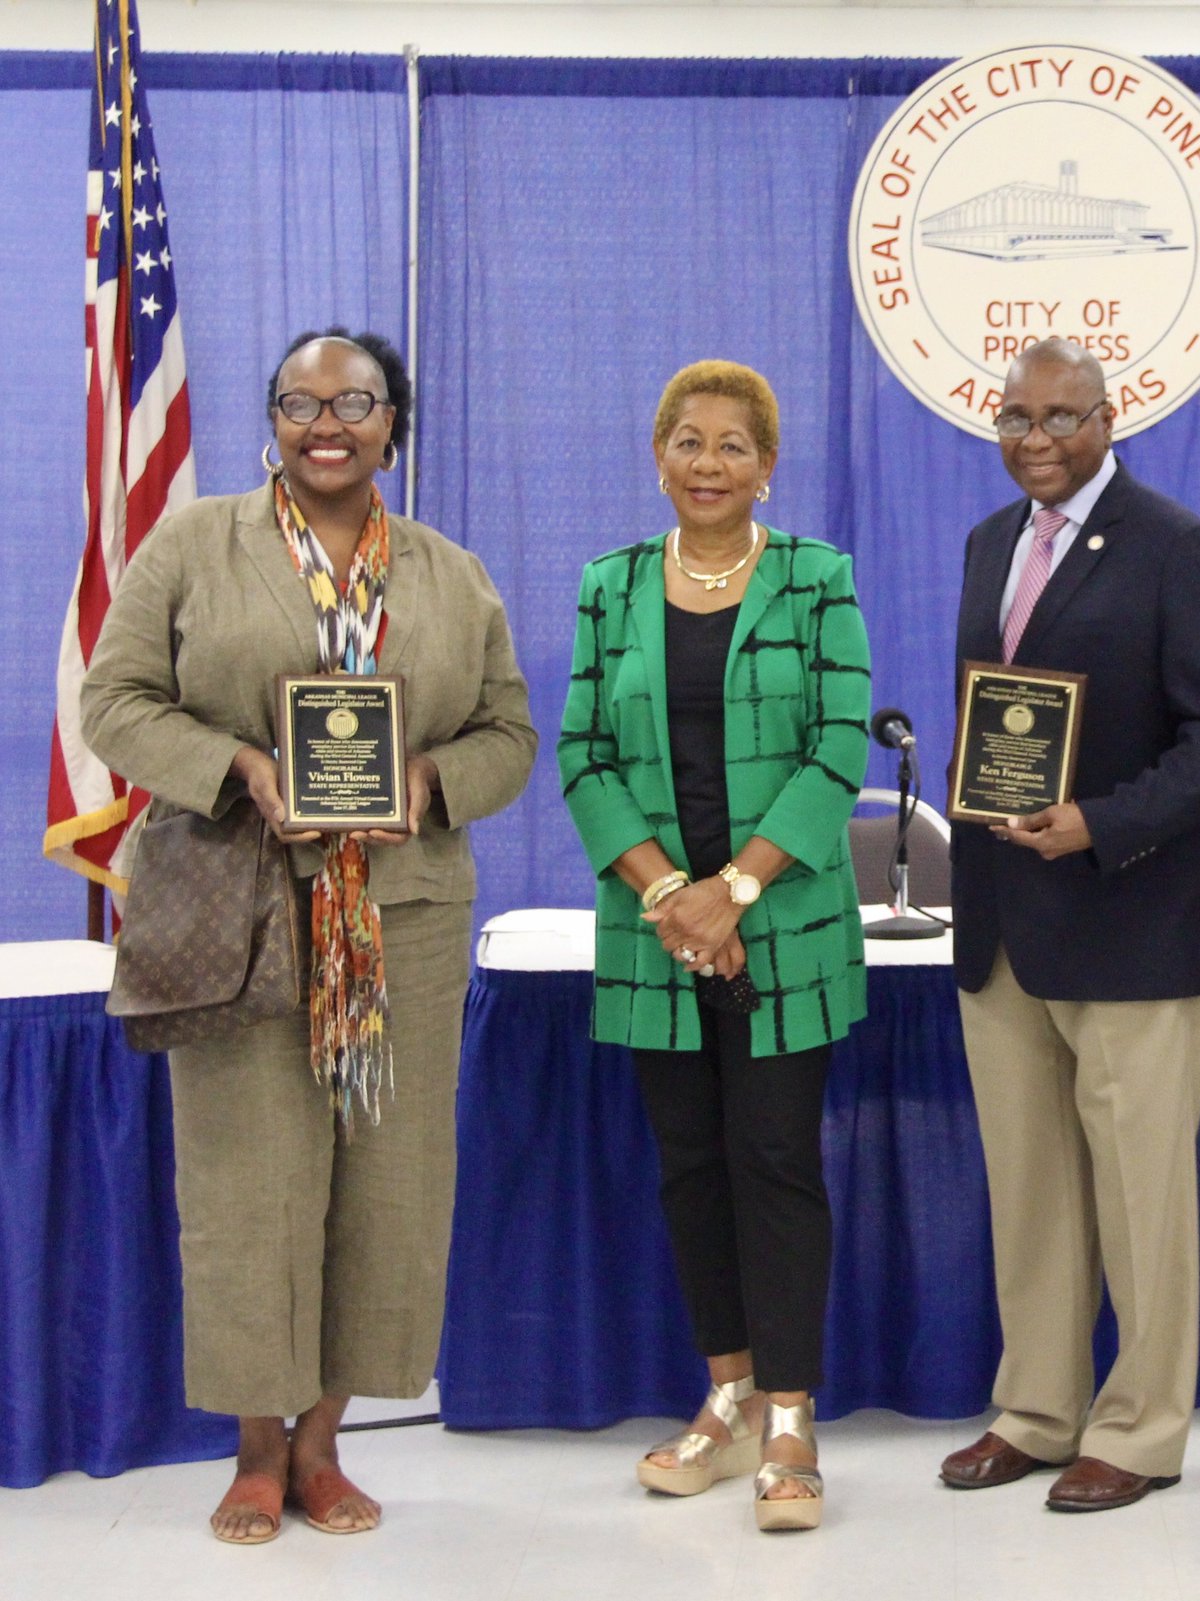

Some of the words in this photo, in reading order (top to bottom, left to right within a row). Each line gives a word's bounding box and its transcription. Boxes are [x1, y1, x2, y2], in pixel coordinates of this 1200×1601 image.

[986, 57, 1074, 98] CITY
[1088, 63, 1142, 102] OF
[907, 83, 977, 145] THE
[880, 147, 916, 199] OF
[870, 214, 911, 312] SEAL
[984, 299, 1061, 330] CITY
[1082, 298, 1121, 329] OF
[308, 771, 341, 782] Vivian
[342, 771, 381, 783] Flowers
[980, 764, 1000, 776] Ken
[1002, 767, 1045, 782] Ferguson
